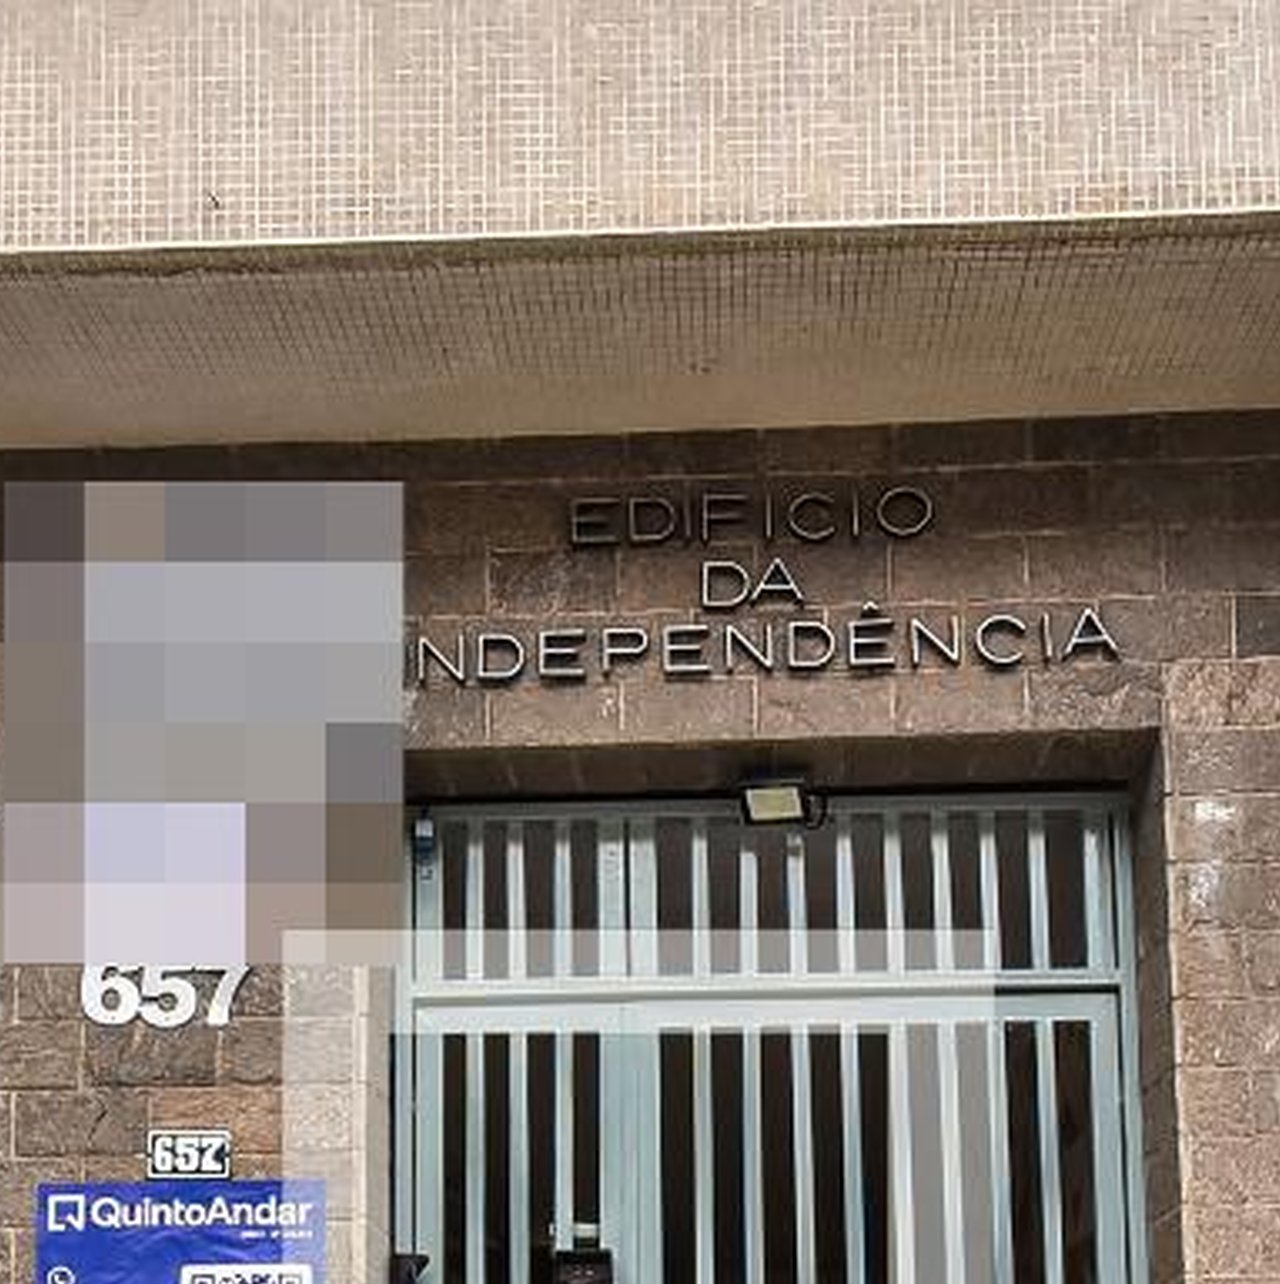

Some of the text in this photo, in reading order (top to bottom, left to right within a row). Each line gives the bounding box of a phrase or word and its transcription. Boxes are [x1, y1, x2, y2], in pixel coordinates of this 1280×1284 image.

[571, 480, 934, 546] EDIFICIO
[702, 556, 806, 608] DA
[418, 601, 1118, 683] NDEPENDÊNCIA
[81, 962, 250, 1028] 657
[90, 1195, 312, 1229] QuintoAndar
